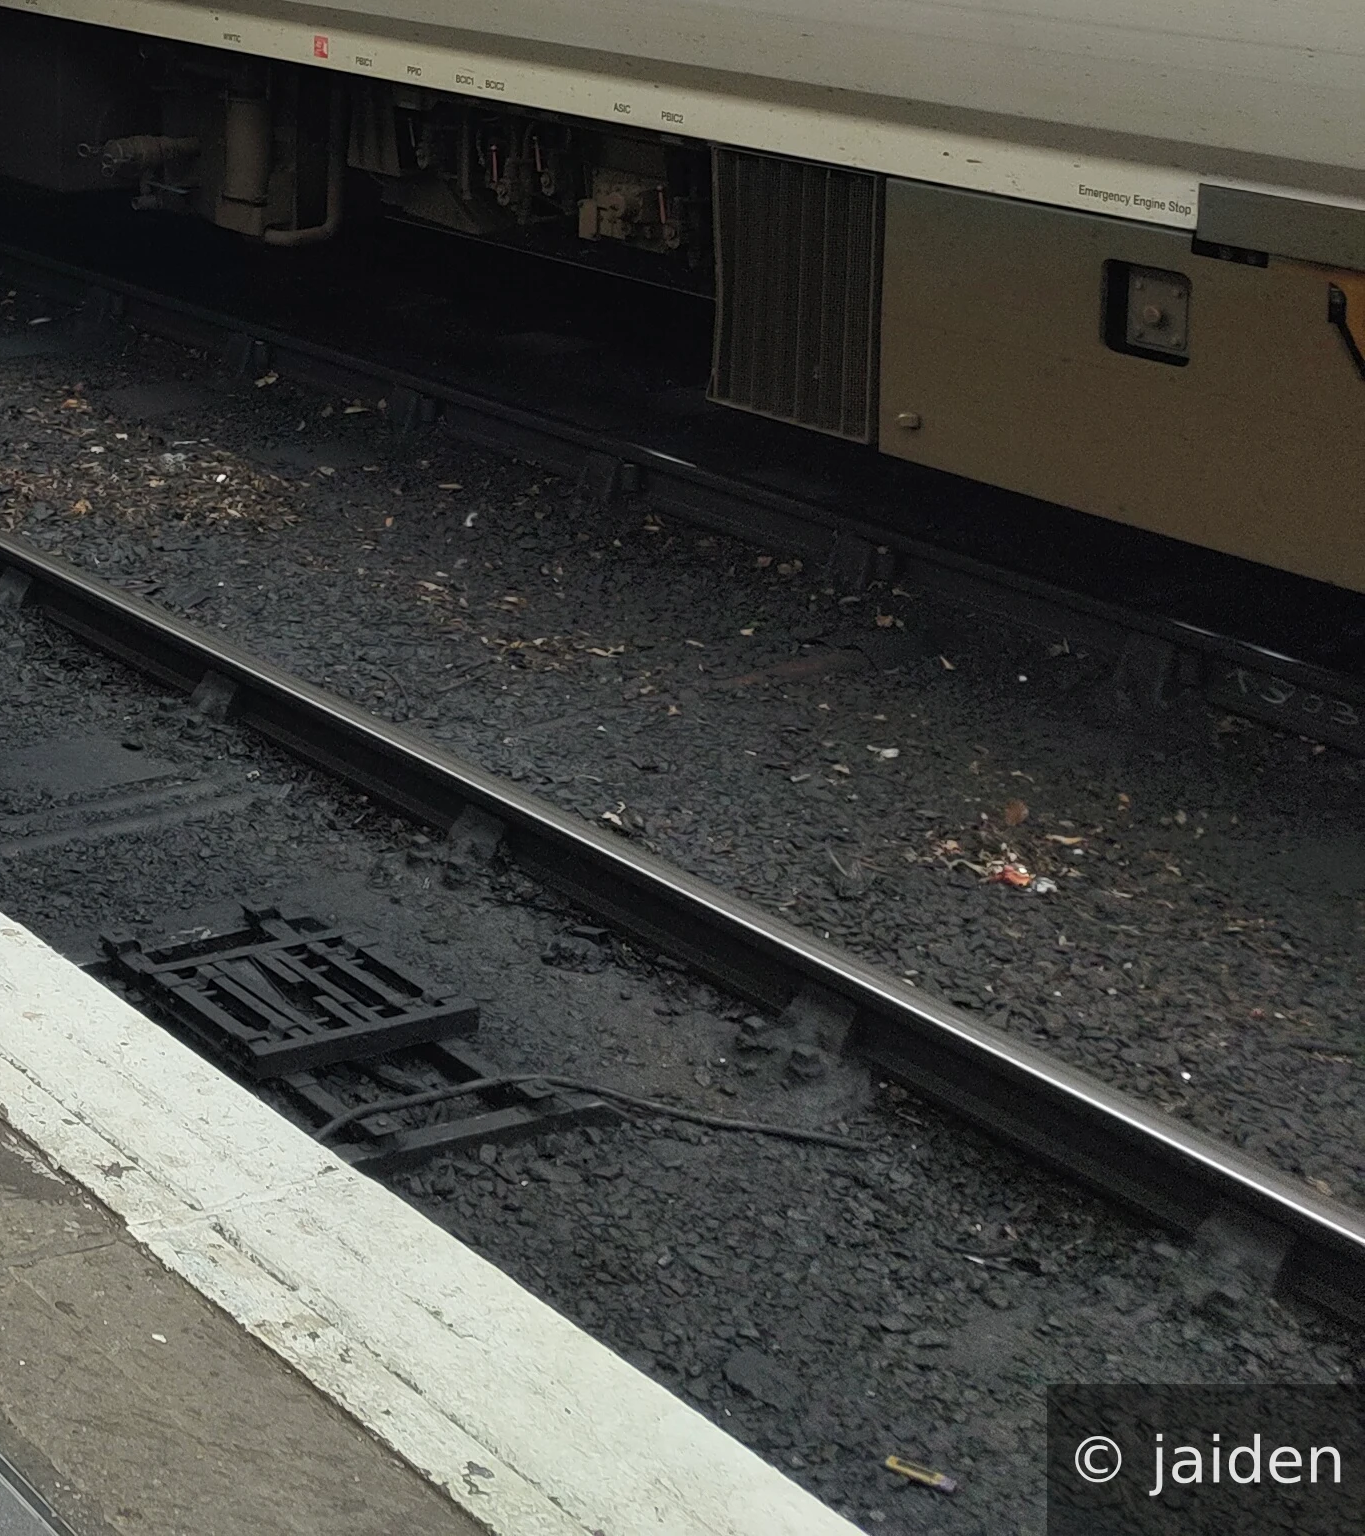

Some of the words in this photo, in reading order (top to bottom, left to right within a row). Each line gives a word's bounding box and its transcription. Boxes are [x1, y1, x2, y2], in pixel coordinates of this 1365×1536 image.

[485, 79, 505, 91] BCIC2
[613, 102, 631, 114] ASIC
[661, 111, 684, 124] PBIC2
[1078, 184, 1131, 206] Emergency
[1133, 194, 1166, 210] Engine
[1168, 201, 1191, 216] Stop
